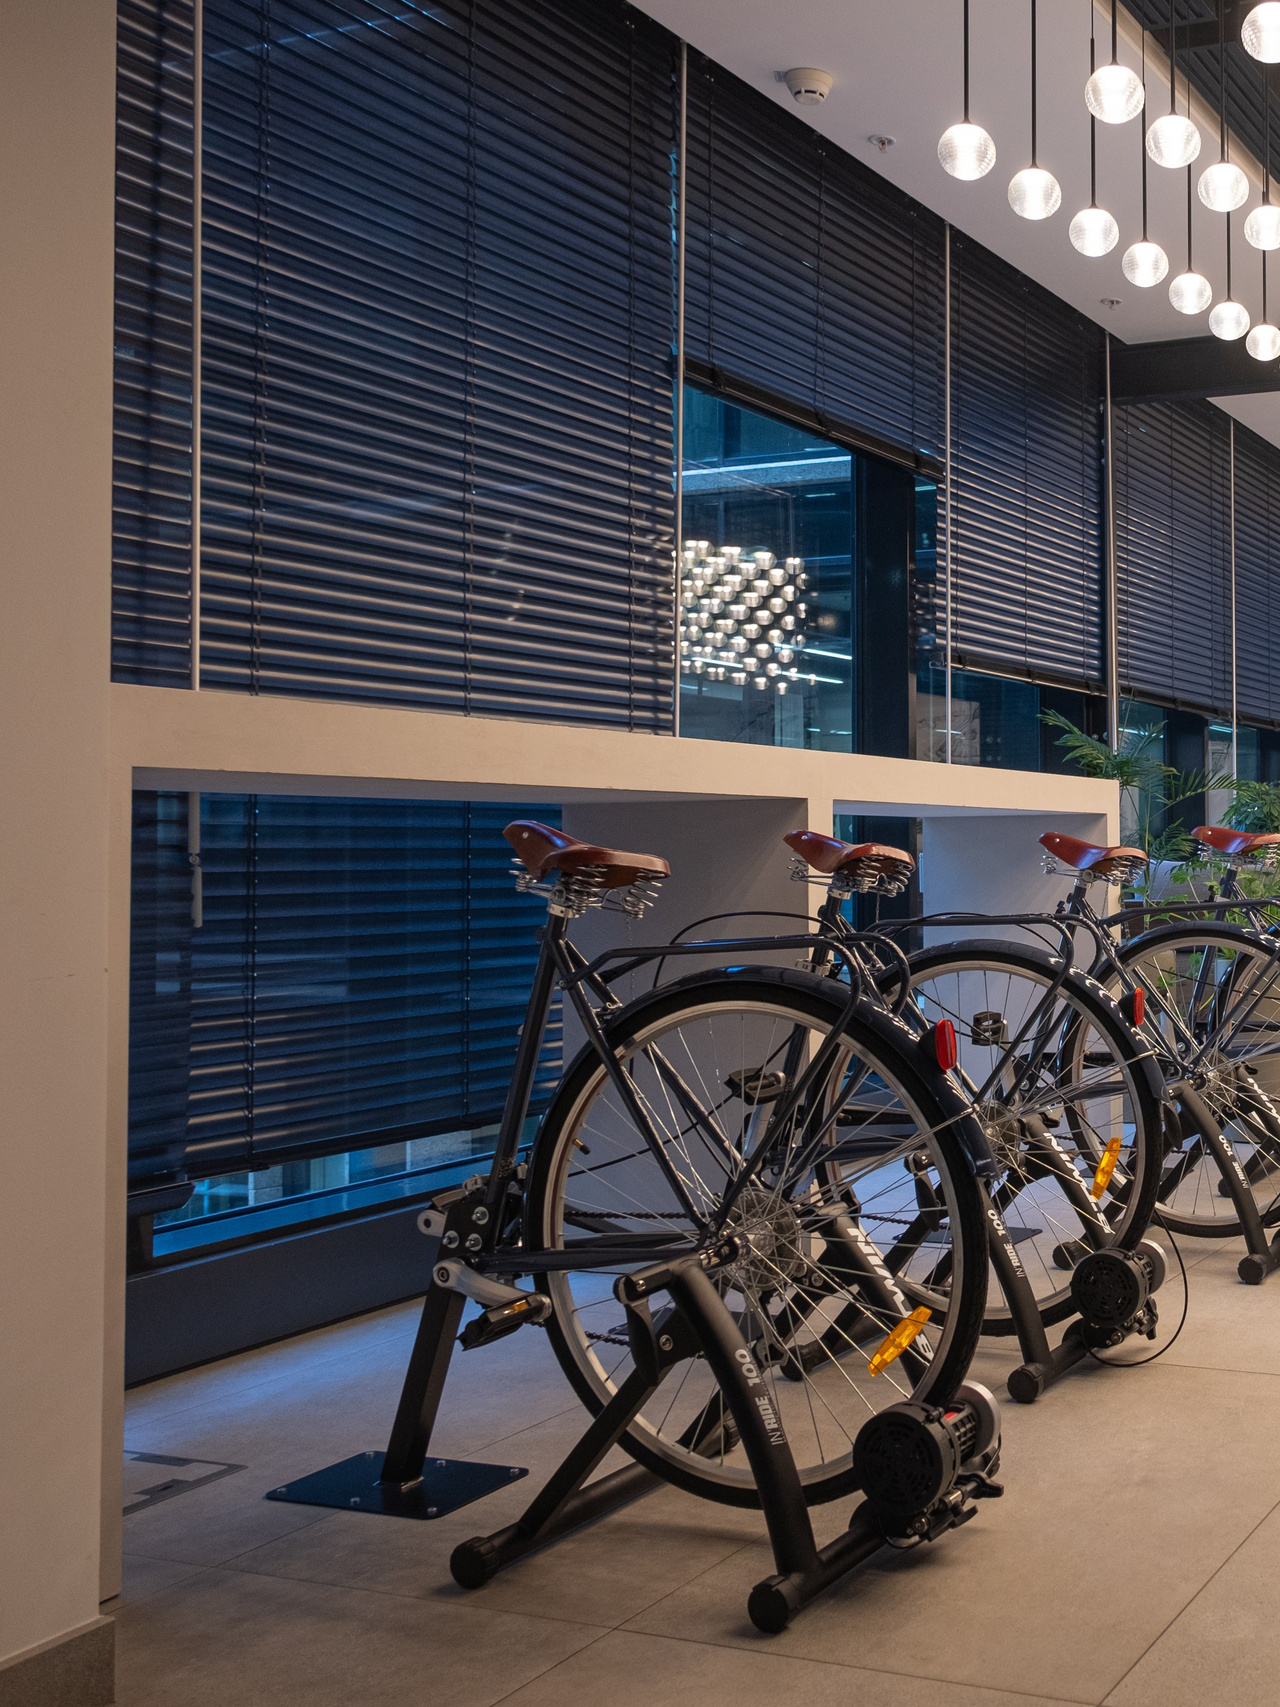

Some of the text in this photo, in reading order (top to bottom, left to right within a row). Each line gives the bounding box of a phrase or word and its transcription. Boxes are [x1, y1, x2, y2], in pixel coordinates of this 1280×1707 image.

[1218, 1134, 1233, 1157] 100
[987, 1209, 1006, 1237] 100
[734, 1348, 761, 1387] 100
